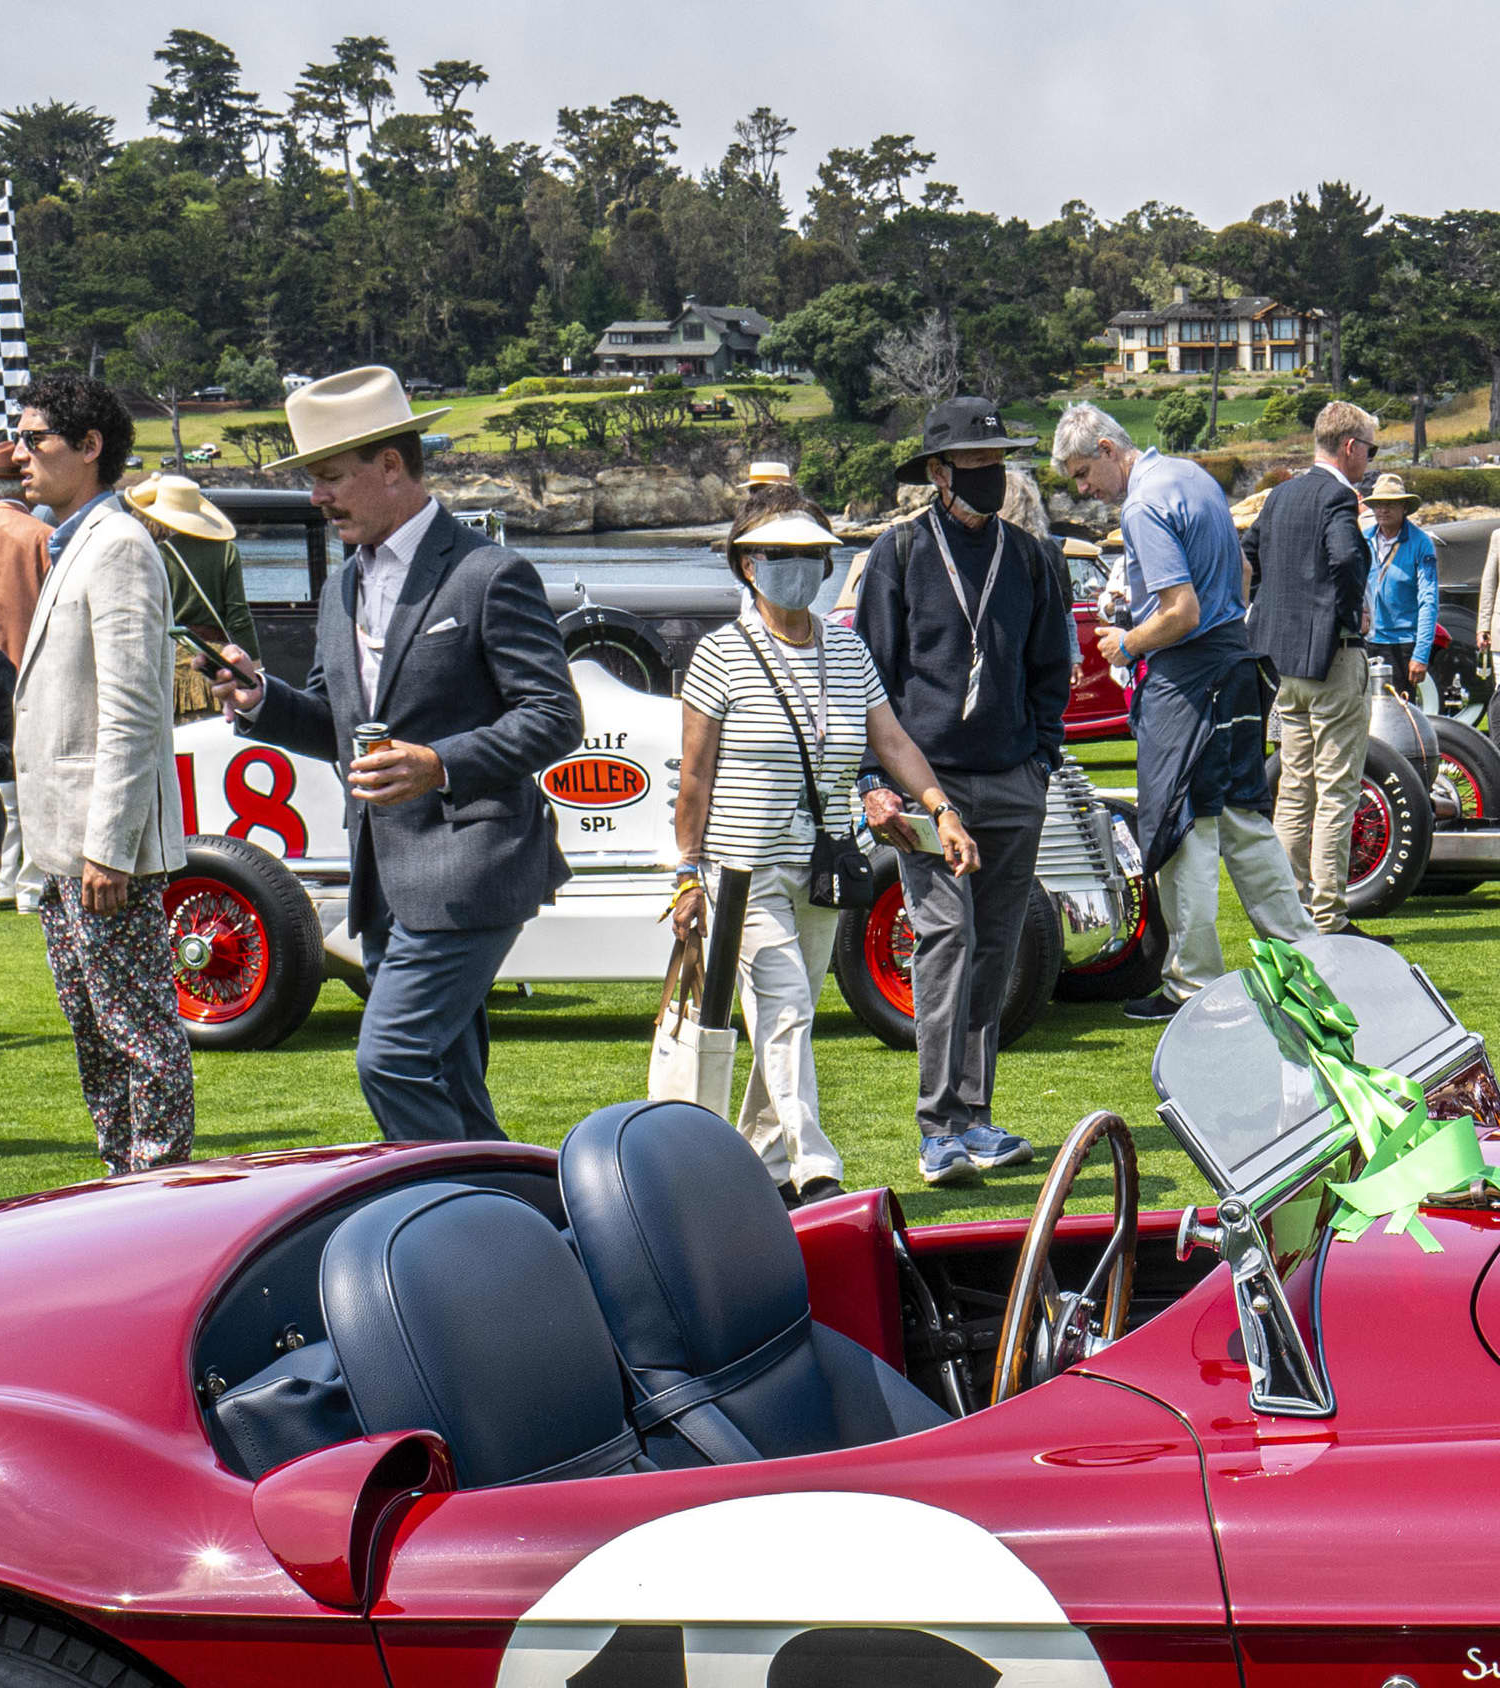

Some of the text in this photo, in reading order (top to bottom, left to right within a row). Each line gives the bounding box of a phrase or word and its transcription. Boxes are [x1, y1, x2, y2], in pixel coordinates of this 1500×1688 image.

[583, 732, 628, 750] ulf
[552, 762, 638, 793] MILLER
[174, 745, 310, 859] 18
[580, 816, 617, 833] SPL
[1384, 771, 1412, 885] Firestone
